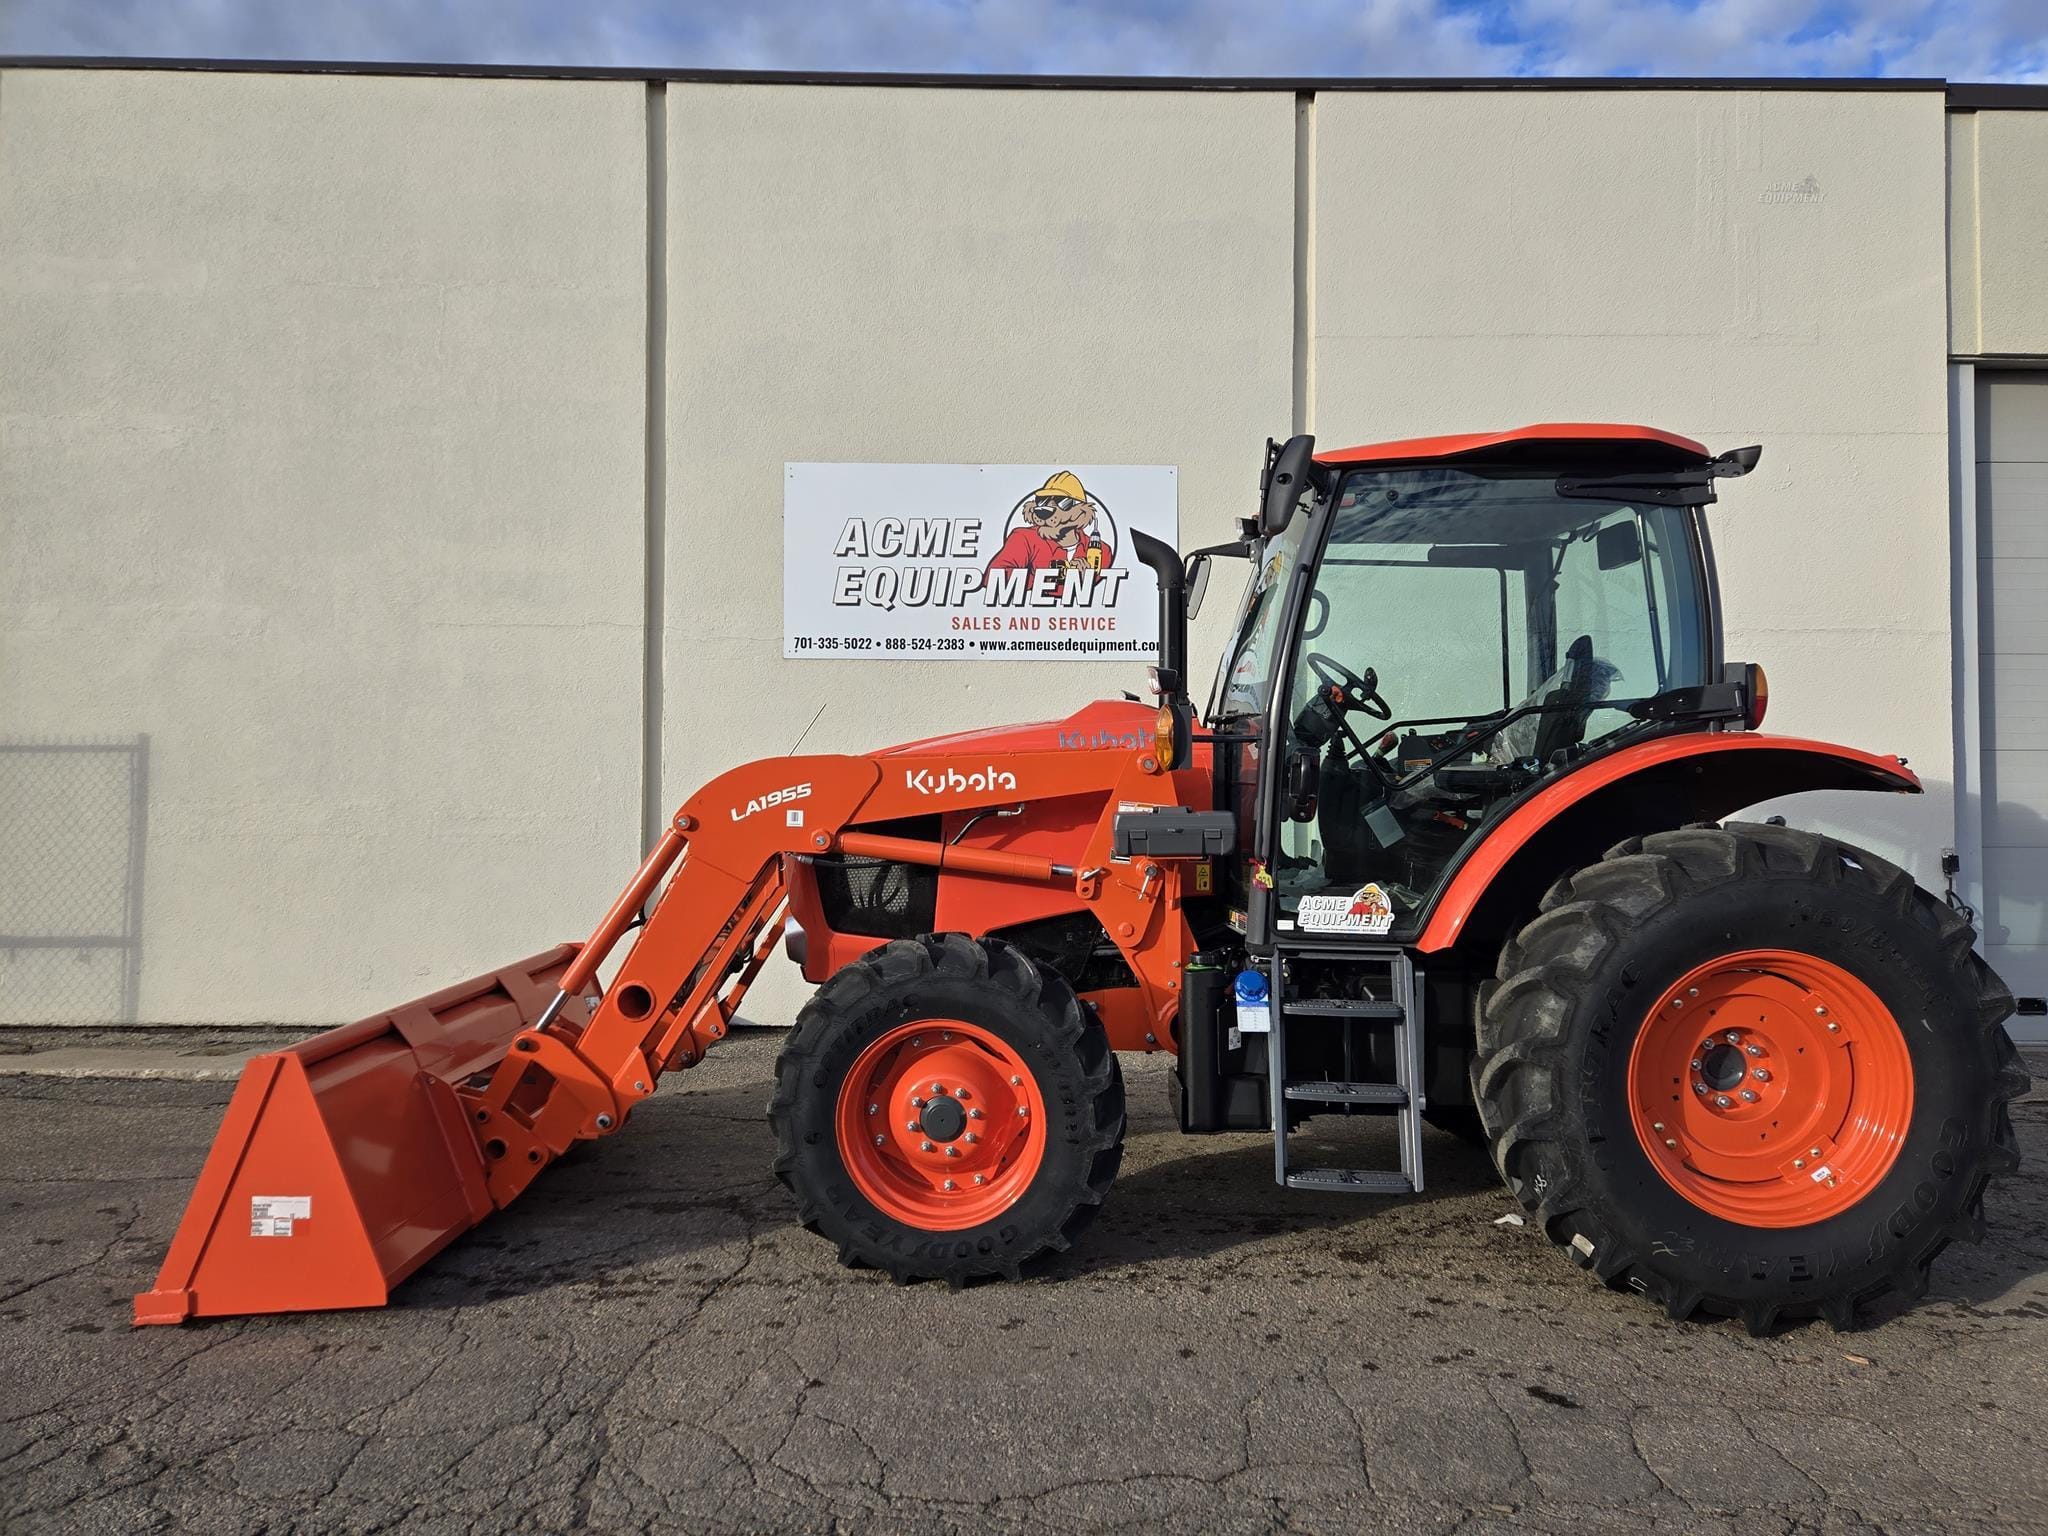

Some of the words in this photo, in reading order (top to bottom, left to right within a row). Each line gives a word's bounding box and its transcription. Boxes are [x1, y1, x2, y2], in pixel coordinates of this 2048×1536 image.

[833, 517, 981, 558] ACME
[832, 566, 1129, 611] EQUIPMENT
[951, 616, 1001, 630] SALES
[1008, 616, 1041, 630] AND
[1048, 617, 1116, 631] SERVICE
[794, 637, 872, 650] 701-335-5022
[885, 638, 965, 650] 888-524-2383
[906, 766, 1017, 795] Kubota
[730, 782, 812, 822] LA1955
[1300, 896, 1347, 912] ACME
[1300, 912, 1393, 928] EQUIPMENT
